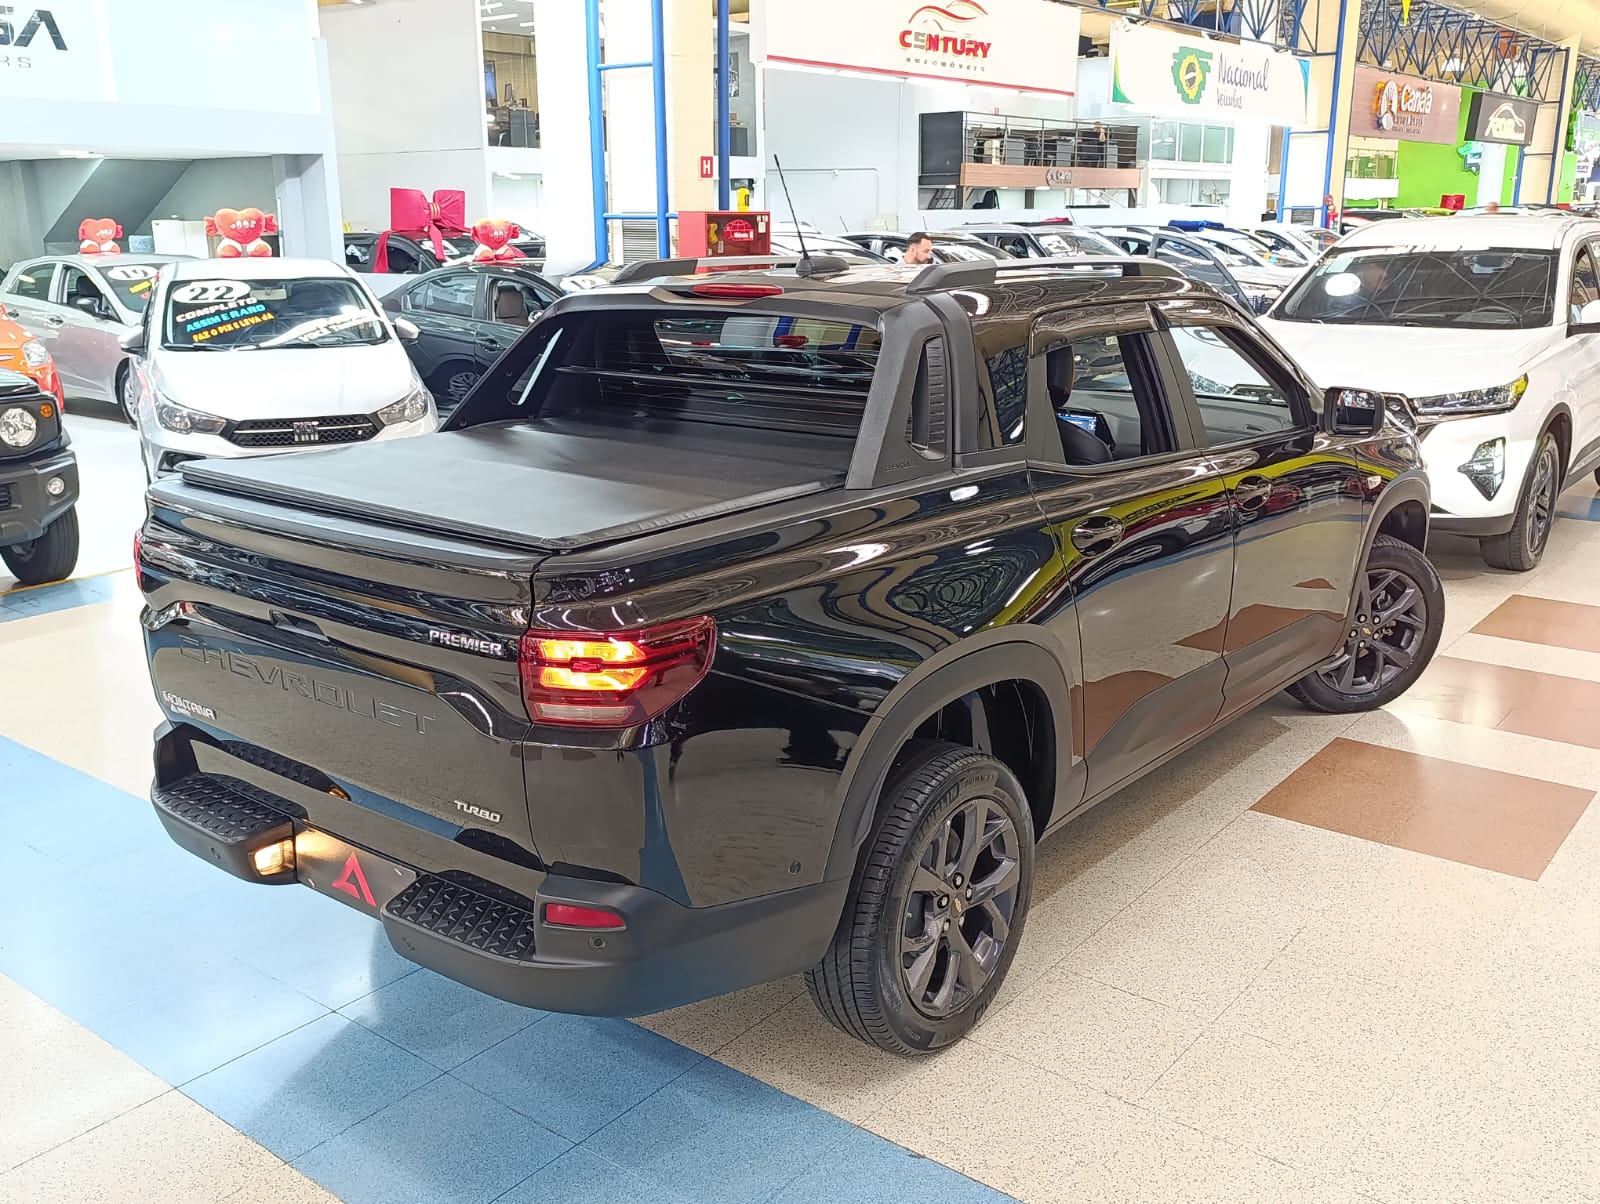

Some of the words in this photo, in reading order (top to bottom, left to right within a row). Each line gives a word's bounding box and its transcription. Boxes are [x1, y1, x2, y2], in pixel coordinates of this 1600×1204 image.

[899, 30, 992, 58] CENTURY
[1218, 51, 1269, 91] Nacional
[703, 160, 711, 175] H
[189, 285, 235, 302] 22
[176, 297, 257, 322] COMPLETO
[186, 315, 220, 332] ASSIM
[229, 304, 266, 319] RARO
[429, 629, 504, 656] PREMIER
[176, 634, 437, 735] CHEVROLET
[162, 690, 217, 720] MONTANA
[454, 800, 502, 823] TURBO
